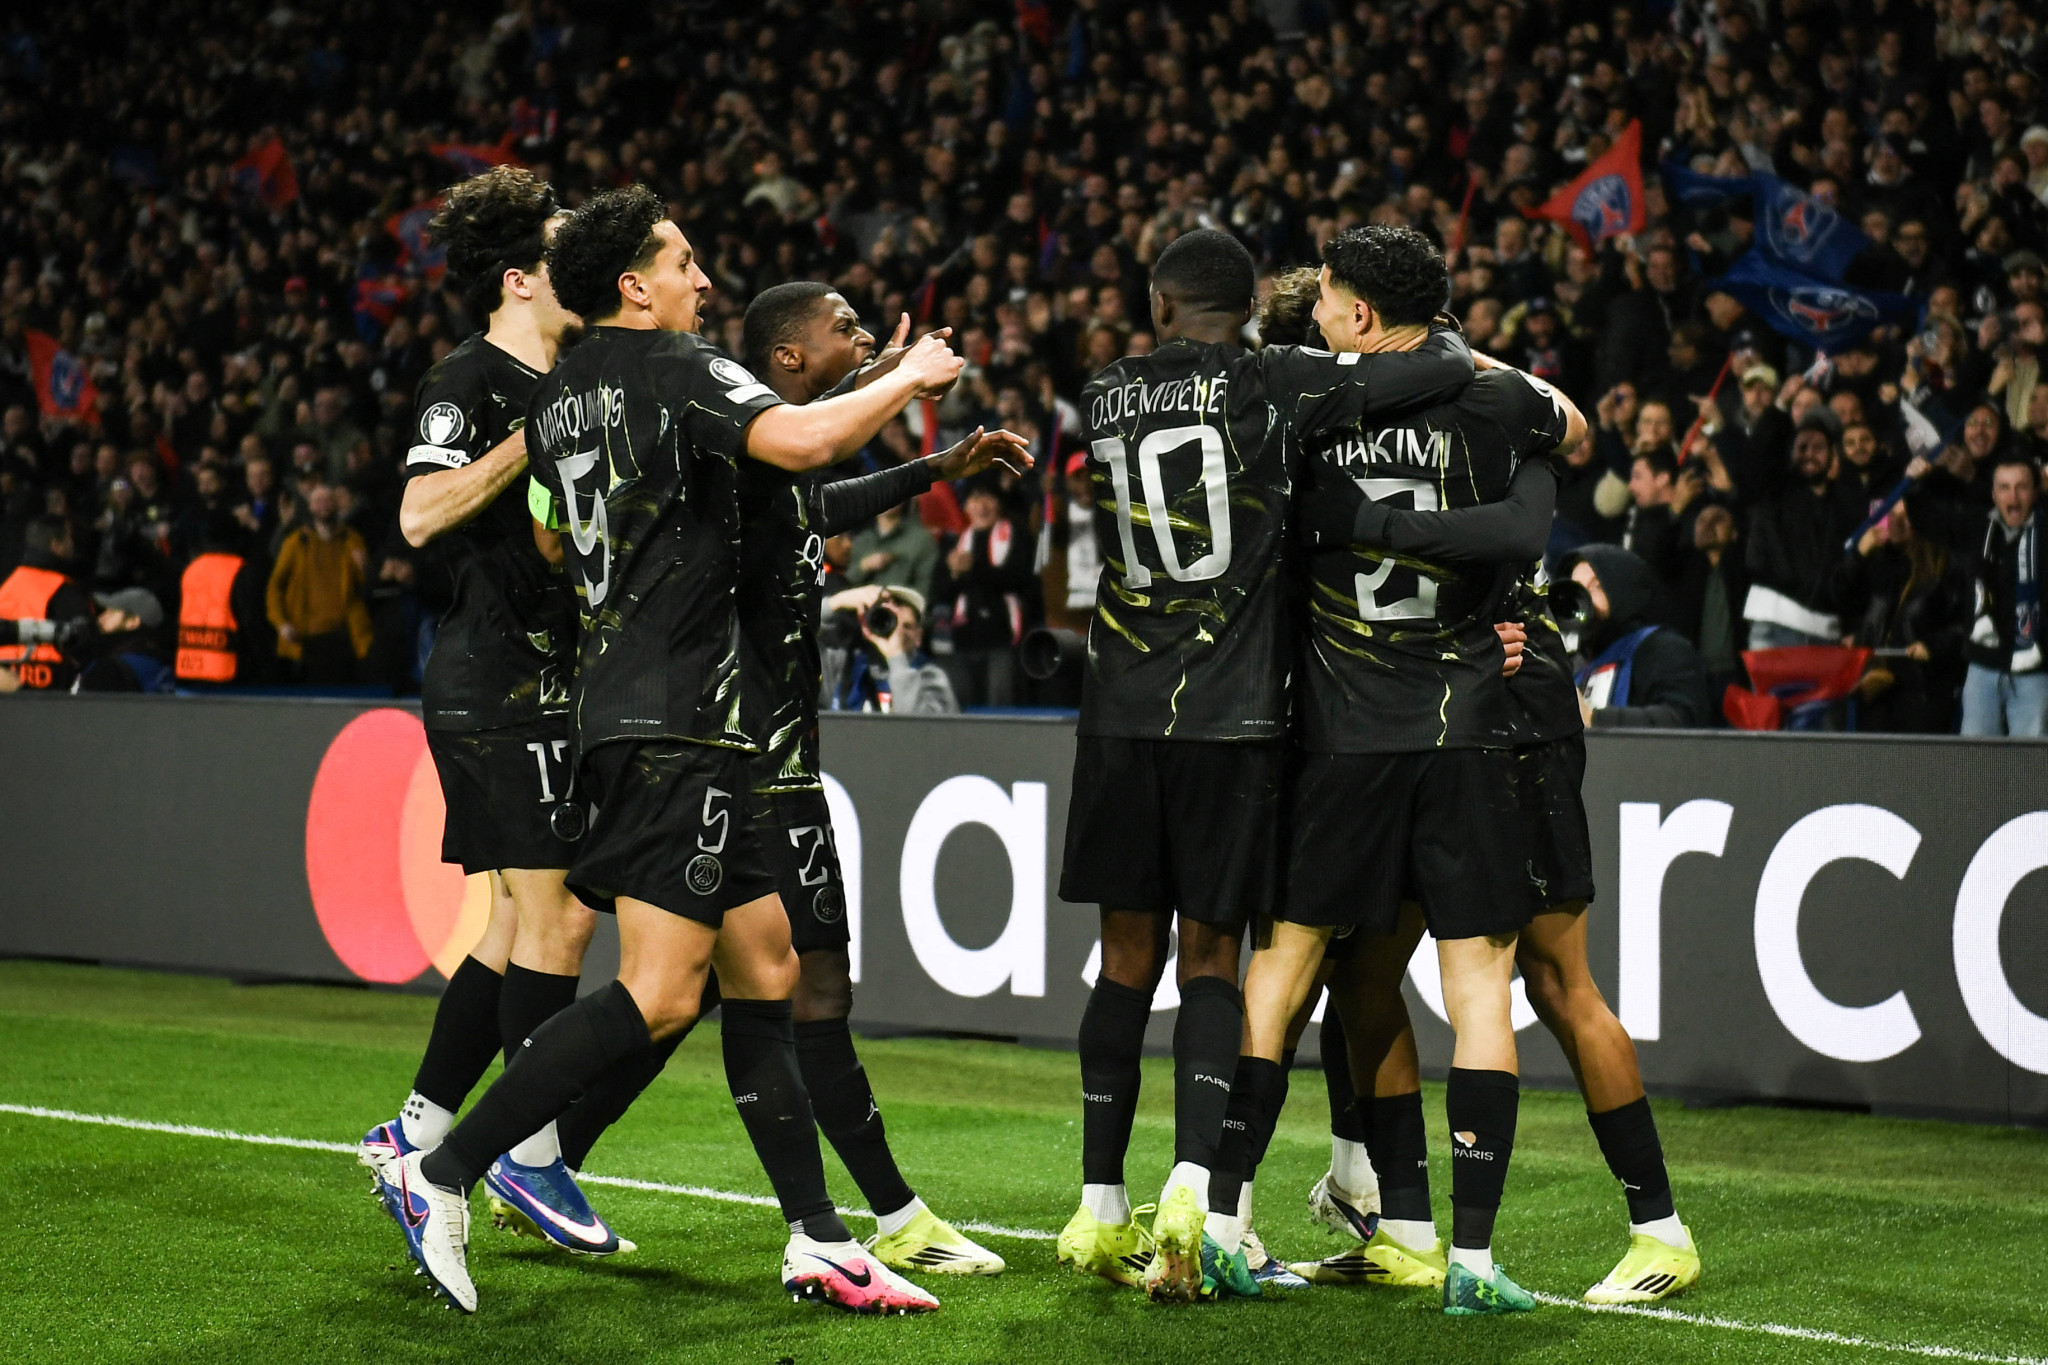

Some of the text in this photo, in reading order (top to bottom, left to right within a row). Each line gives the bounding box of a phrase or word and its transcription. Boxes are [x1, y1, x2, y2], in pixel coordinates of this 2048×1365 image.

[554, 445, 611, 611] 5
[1090, 424, 1232, 590] 10
[1353, 478, 1438, 621] 2
[697, 786, 732, 854] 5
[734, 1092, 759, 1105] RIS
[1194, 1073, 1231, 1092] PARIS
[1222, 1119, 1246, 1131] RIS
[1453, 1147, 1494, 1161] PARIS
